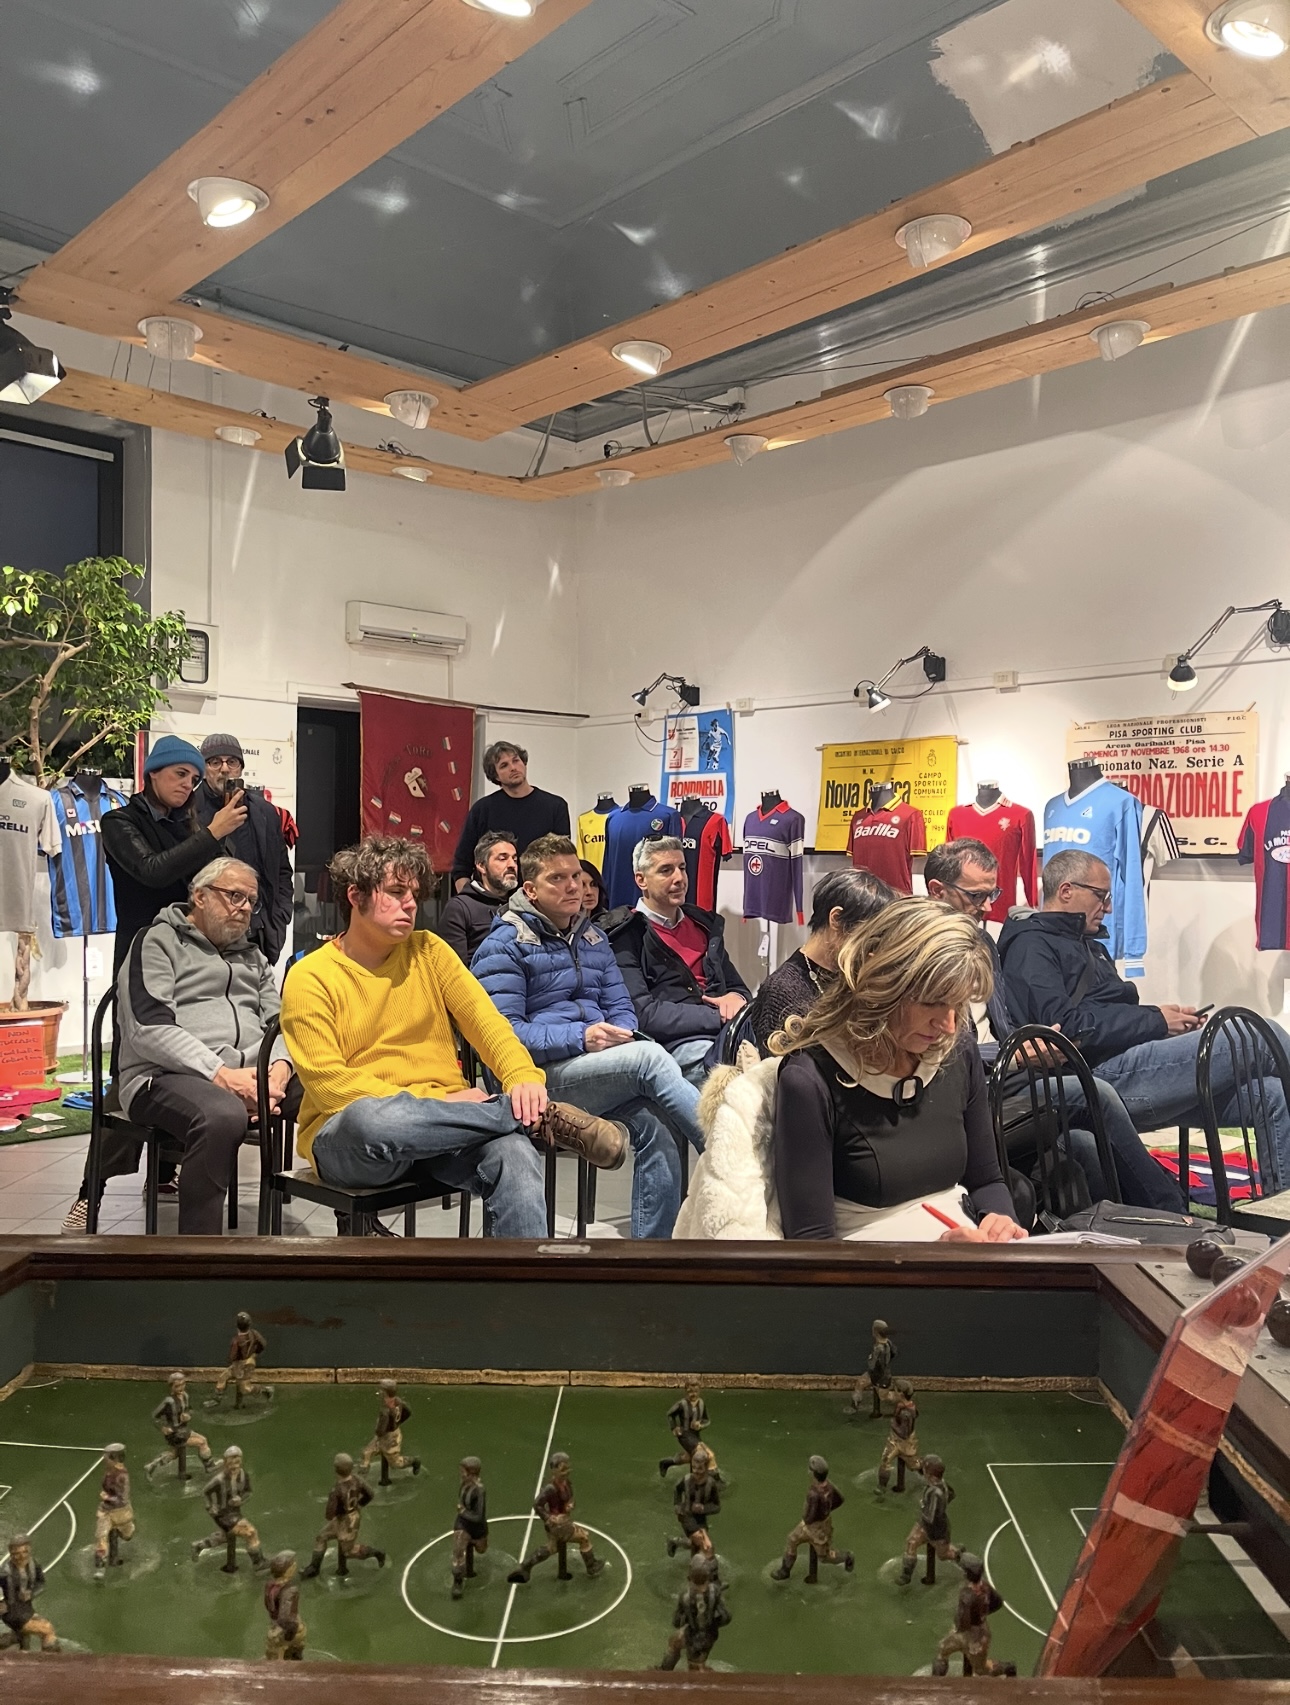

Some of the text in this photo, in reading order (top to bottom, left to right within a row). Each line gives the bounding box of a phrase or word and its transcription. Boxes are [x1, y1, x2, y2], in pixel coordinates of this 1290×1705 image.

[1109, 725, 1202, 738] PISA SPORTING CLUB
[1083, 750, 1118, 758] DOMENICA
[1130, 747, 1170, 756] NOVEMBRE
[1172, 746, 1190, 754] 1968
[1209, 744, 1230, 752] 14.30
[1134, 740, 1175, 748] Garibaldi
[1099, 755, 1244, 771] pionato Naz. Serie A
[670, 779, 725, 798] RONDINELLA
[825, 779, 860, 808] Nova
[0, 821, 28, 834] RELLI
[854, 823, 899, 839] Barilla
[1204, 837, 1228, 846] C.
